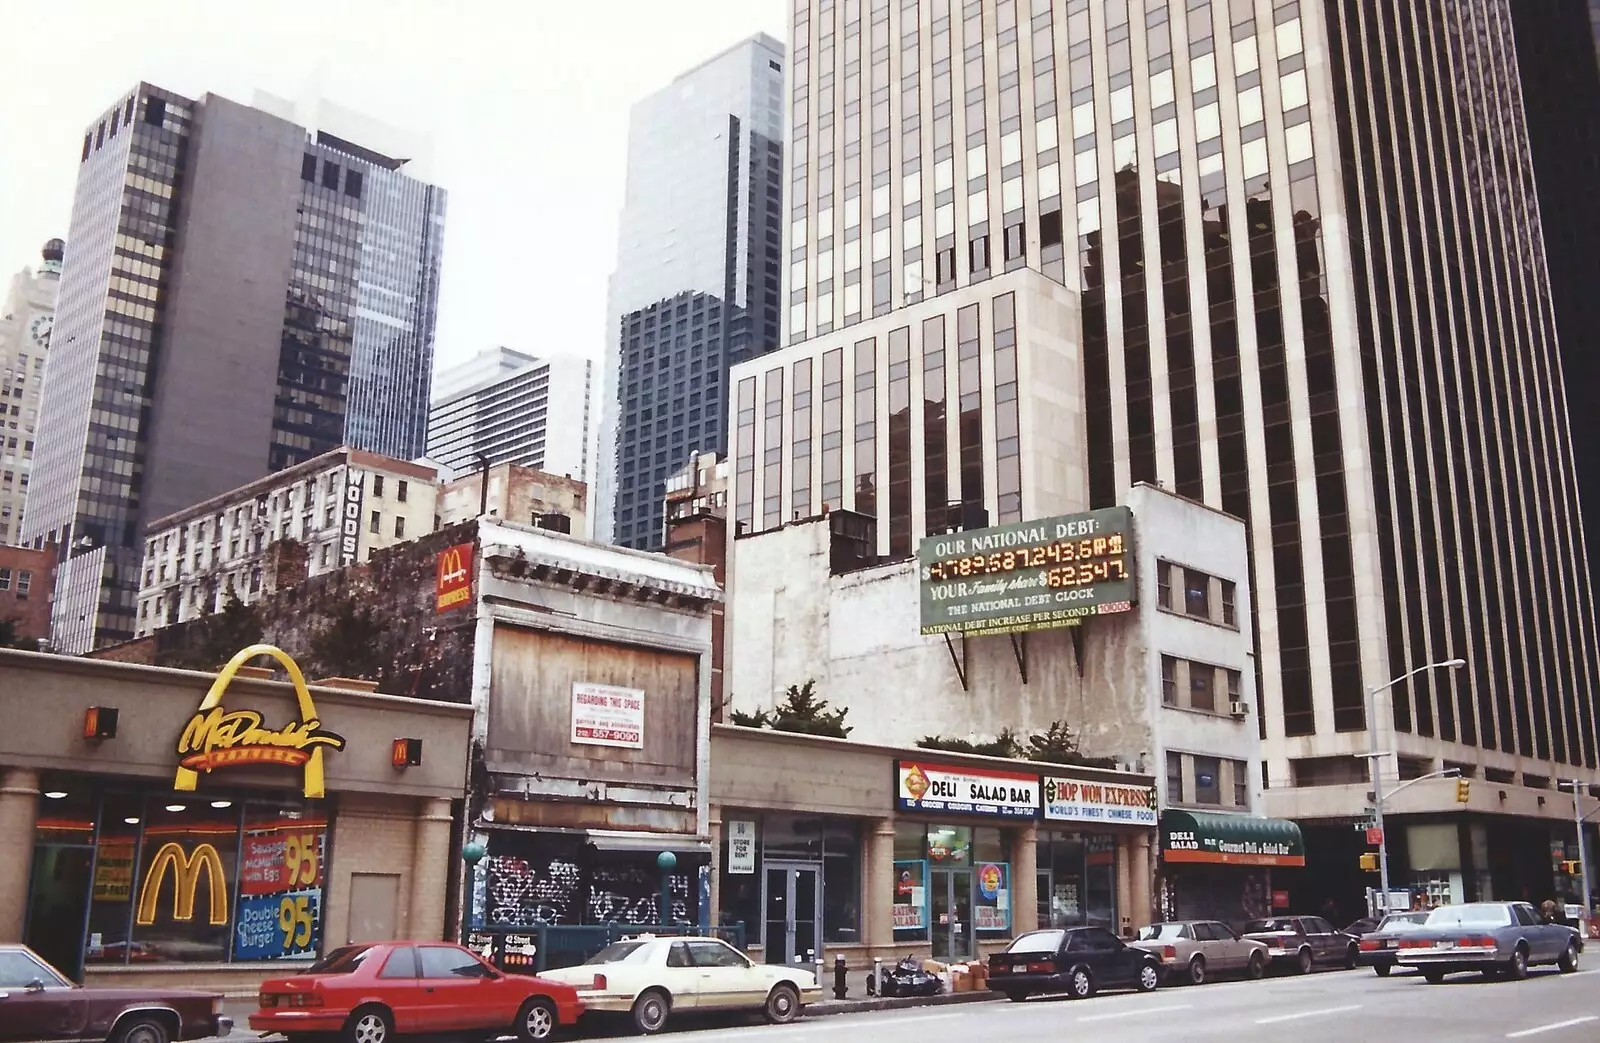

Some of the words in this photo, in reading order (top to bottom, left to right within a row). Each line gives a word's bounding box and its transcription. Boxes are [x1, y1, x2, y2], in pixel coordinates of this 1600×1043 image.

[936, 540, 966, 557] OUR
[972, 527, 1048, 552] NATIONAL
[1056, 519, 1099, 538] DEBT:
[930, 582, 968, 600] YOUR
[968, 578, 1008, 596] Family
[1007, 575, 1039, 590] share
[947, 604, 968, 616] THE
[971, 597, 1021, 614] NATIONAL
[1025, 593, 1051, 605] DEBT
[1055, 588, 1094, 602] CLOCK
[922, 622, 963, 635] NATIONAL
[964, 619, 987, 630] DEBT
[988, 613, 1031, 626] INCREASE
[1033, 612, 1051, 622] PER
[1052, 607, 1089, 619] SECOND
[979, 627, 1010, 636] INTEREST
[1011, 623, 1029, 632] COST
[1052, 617, 1080, 628] BILLION
[576, 693, 608, 707] REGARDING
[610, 696, 622, 709] THIS
[624, 699, 641, 711] SPACE
[592, 729, 639, 742] 557-9090
[932, 780, 957, 798] DELI
[970, 783, 1007, 802] SALAD
[1010, 788, 1031, 804] BAR
[1056, 781, 1078, 802] HOP
[1080, 783, 1102, 804] WON
[1105, 786, 1148, 807] EXPRESS
[1048, 804, 1079, 816] WORLD'S
[1082, 807, 1104, 817] FINEST
[1108, 809, 1132, 820] CHINESE
[1136, 811, 1154, 821] FOOD
[733, 838, 750, 846] STORE
[1169, 831, 1195, 841] DELI
[251, 841, 287, 856] Sausage
[1170, 840, 1199, 850] SALAD
[1218, 839, 1245, 853] Gourmet
[1245, 841, 1258, 854] Deli
[1262, 843, 1278, 855] Salad
[1279, 844, 1290, 855] Bar
[285, 834, 319, 886] 95
[734, 851, 748, 859] RENT
[264, 868, 280, 883] Egg
[244, 905, 280, 922] Double
[237, 920, 274, 935] Cheese
[279, 896, 314, 949] 95
[241, 931, 275, 948] Burger
[505, 935, 513, 944] 42
[513, 936, 531, 945] Street
